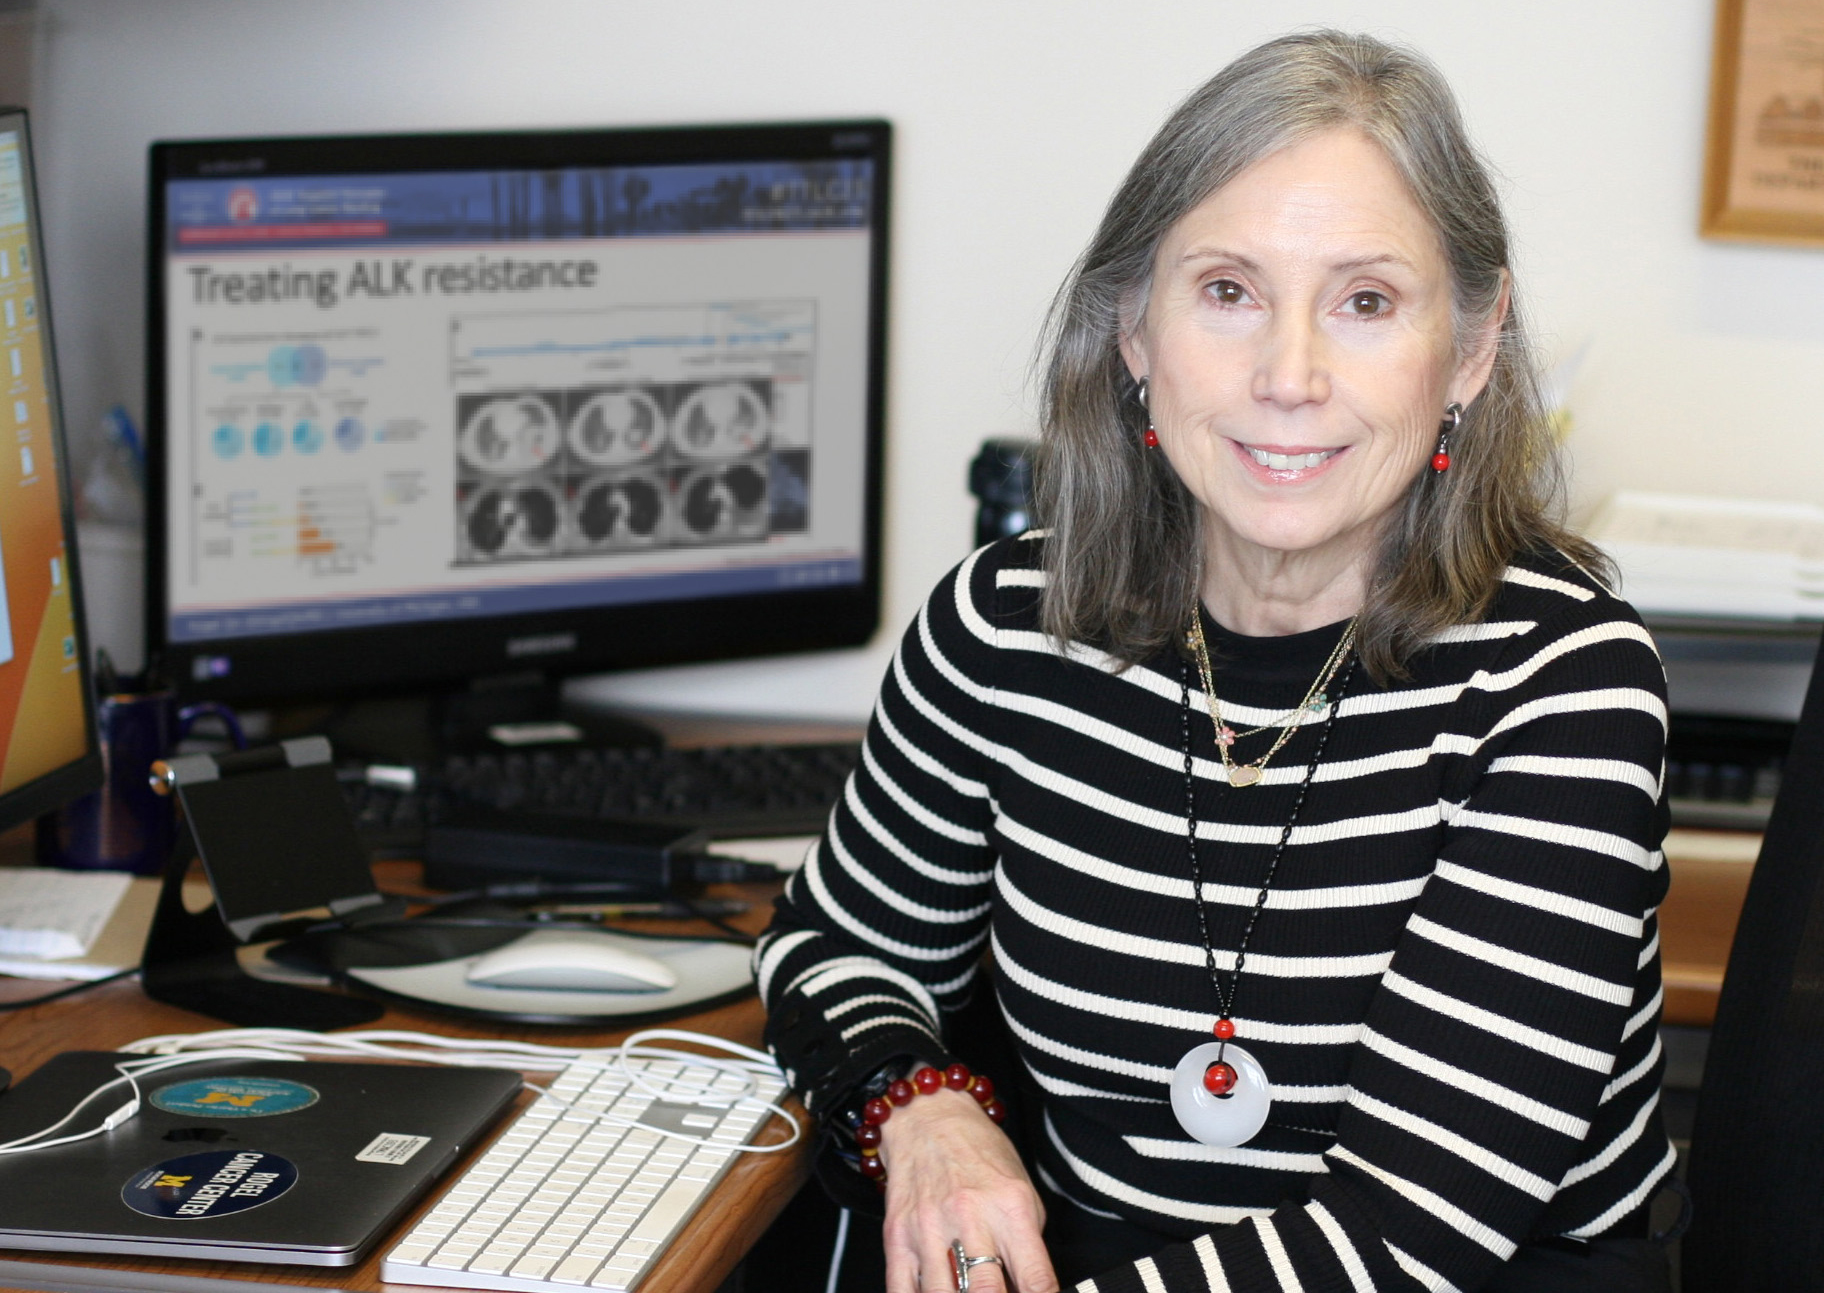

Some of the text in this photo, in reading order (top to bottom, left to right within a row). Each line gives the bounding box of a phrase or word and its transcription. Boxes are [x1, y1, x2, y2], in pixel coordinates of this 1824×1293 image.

[188, 254, 599, 310] Treating ALK resistance
[175, 1152, 264, 1216] CANCER CENTER
[229, 1171, 280, 1198] ROGEL
